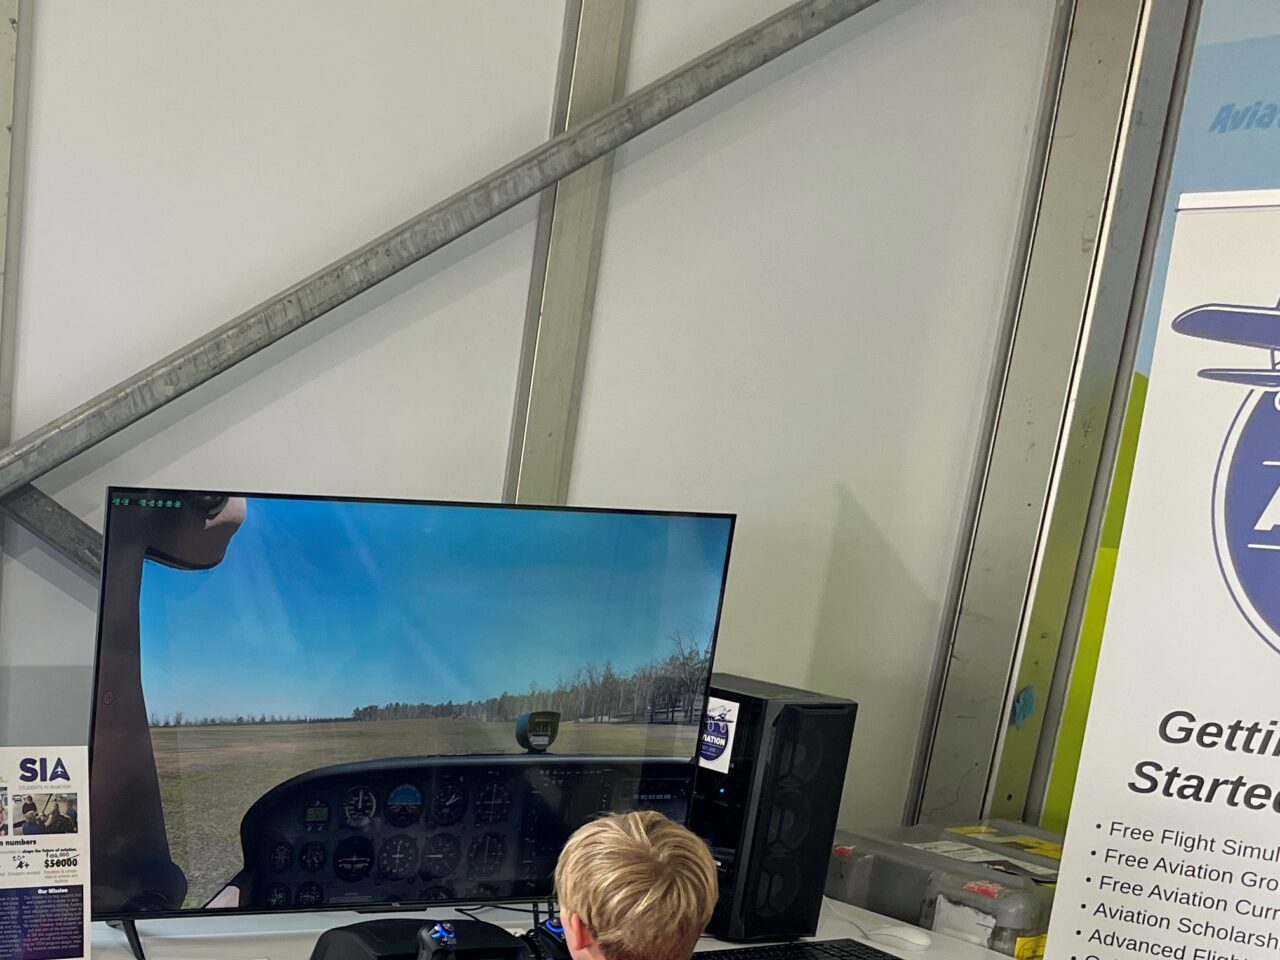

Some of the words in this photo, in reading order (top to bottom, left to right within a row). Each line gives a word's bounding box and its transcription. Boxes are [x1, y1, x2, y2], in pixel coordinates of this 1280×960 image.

[1208, 101, 1280, 134] Avia
[19, 757, 71, 782] SIA
[5, 838, 37, 846] numbers
[1109, 821, 1154, 842] Free
[1161, 829, 1216, 853] Flight
[1104, 848, 1148, 869] Free
[1153, 857, 1233, 884] Aviation
[1099, 875, 1143, 896] Free
[1147, 884, 1228, 912] Aviation
[1093, 902, 1170, 930] Aviation
[1177, 917, 1280, 950] Scholarsh
[1088, 928, 1186, 960] Advanced
